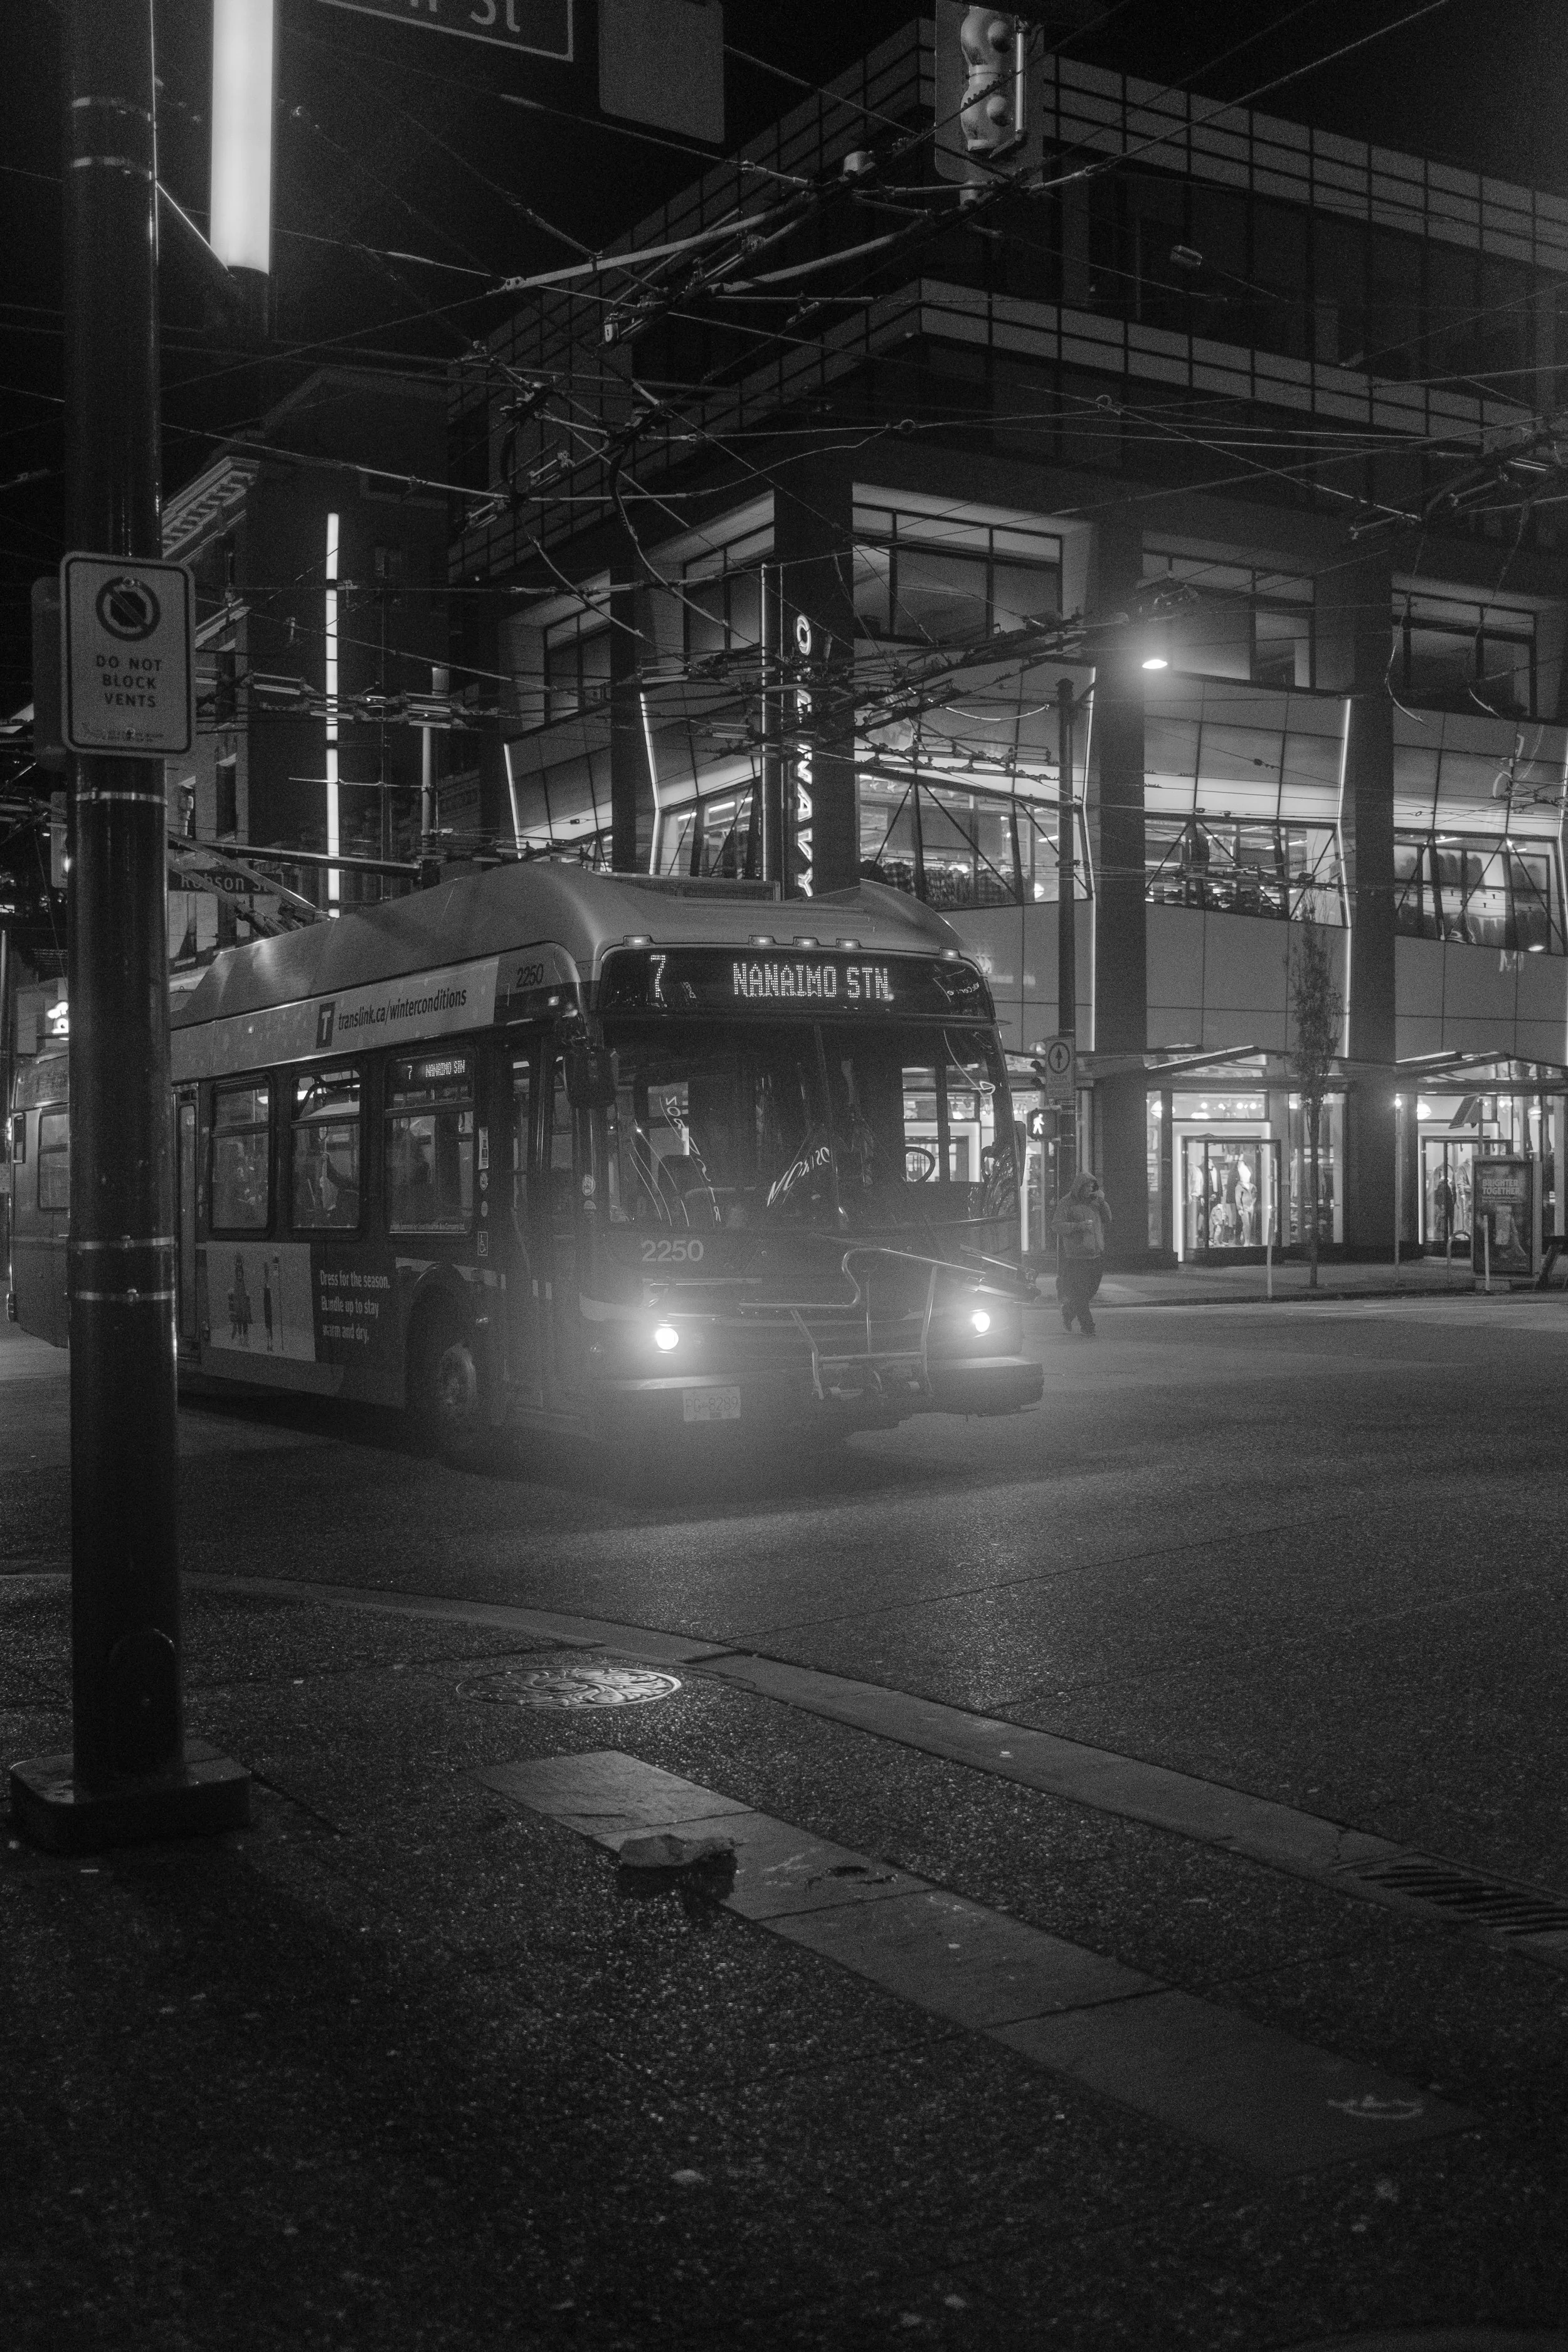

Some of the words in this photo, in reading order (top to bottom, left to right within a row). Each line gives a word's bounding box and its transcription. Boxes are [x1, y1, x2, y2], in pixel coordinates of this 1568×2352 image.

[96, 655, 119, 669] DO
[129, 658, 162, 671] NOT
[102, 674, 157, 689] BLOCK
[103, 692, 156, 707] VENTS
[796, 744, 813, 898] NAVY
[516, 963, 544, 988] 2250
[650, 954, 667, 999] 7
[732, 962, 837, 998] NANAIMO
[845, 966, 889, 999] STN
[337, 987, 467, 1030] translink.ca/winterconditions
[406, 1065, 413, 1080] 7
[425, 1061, 452, 1078] NANAIMO
[452, 1059, 466, 1074] STN
[640, 1239, 704, 1262] 2250
[319, 1269, 339, 1286] Dress
[339, 1269, 350, 1286] for
[350, 1271, 363, 1288] the
[363, 1275, 391, 1290] season.
[344, 1300, 354, 1316] up
[355, 1298, 363, 1315] to
[364, 1298, 379, 1319] stay
[341, 1323, 355, 1340] and
[356, 1323, 370, 1345] dry.
